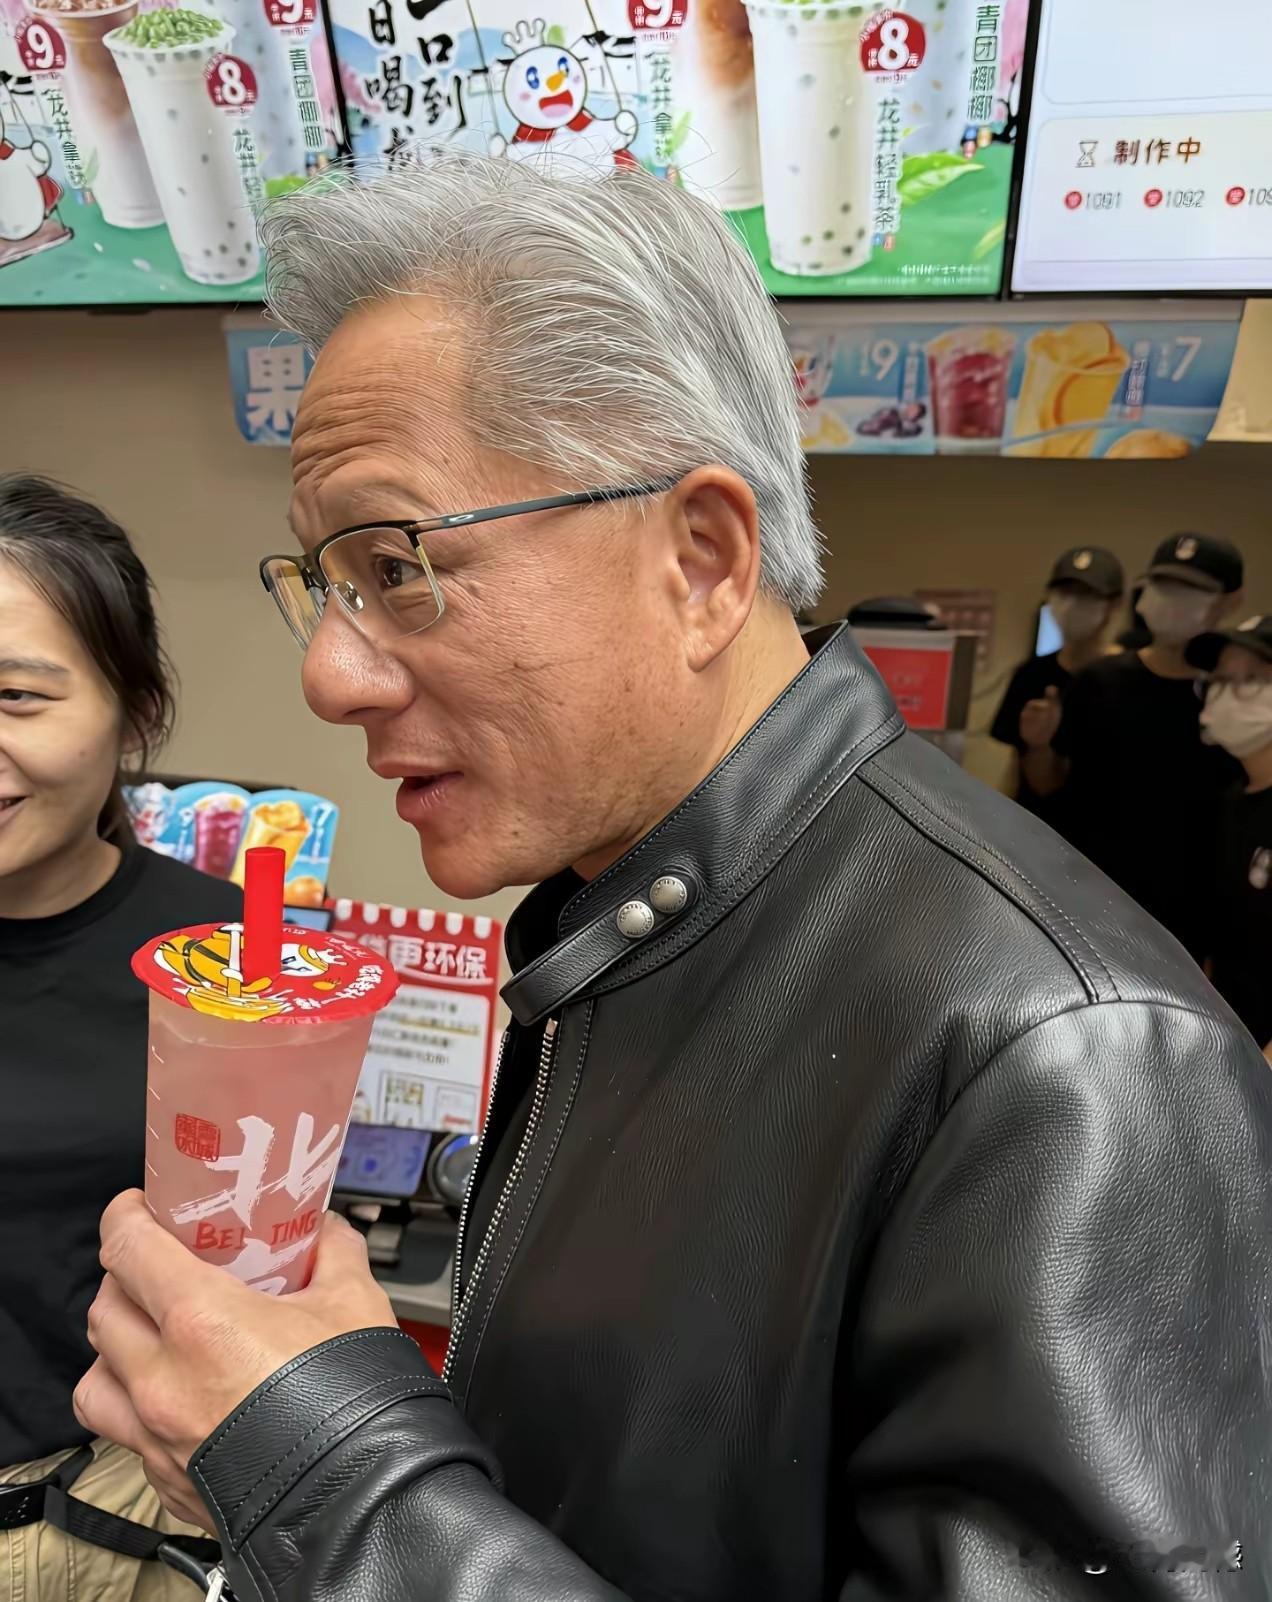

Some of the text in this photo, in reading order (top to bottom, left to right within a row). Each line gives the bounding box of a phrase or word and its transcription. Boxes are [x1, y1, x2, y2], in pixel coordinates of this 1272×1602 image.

[27, 24, 55, 69] 9
[880, 18, 910, 70] 8
[218, 61, 246, 105] 8
[1113, 136, 1201, 166] 制作中
[872, 339, 898, 381] 9
[1172, 336, 1202, 382] 7
[192, 1221, 245, 1250] BEI
